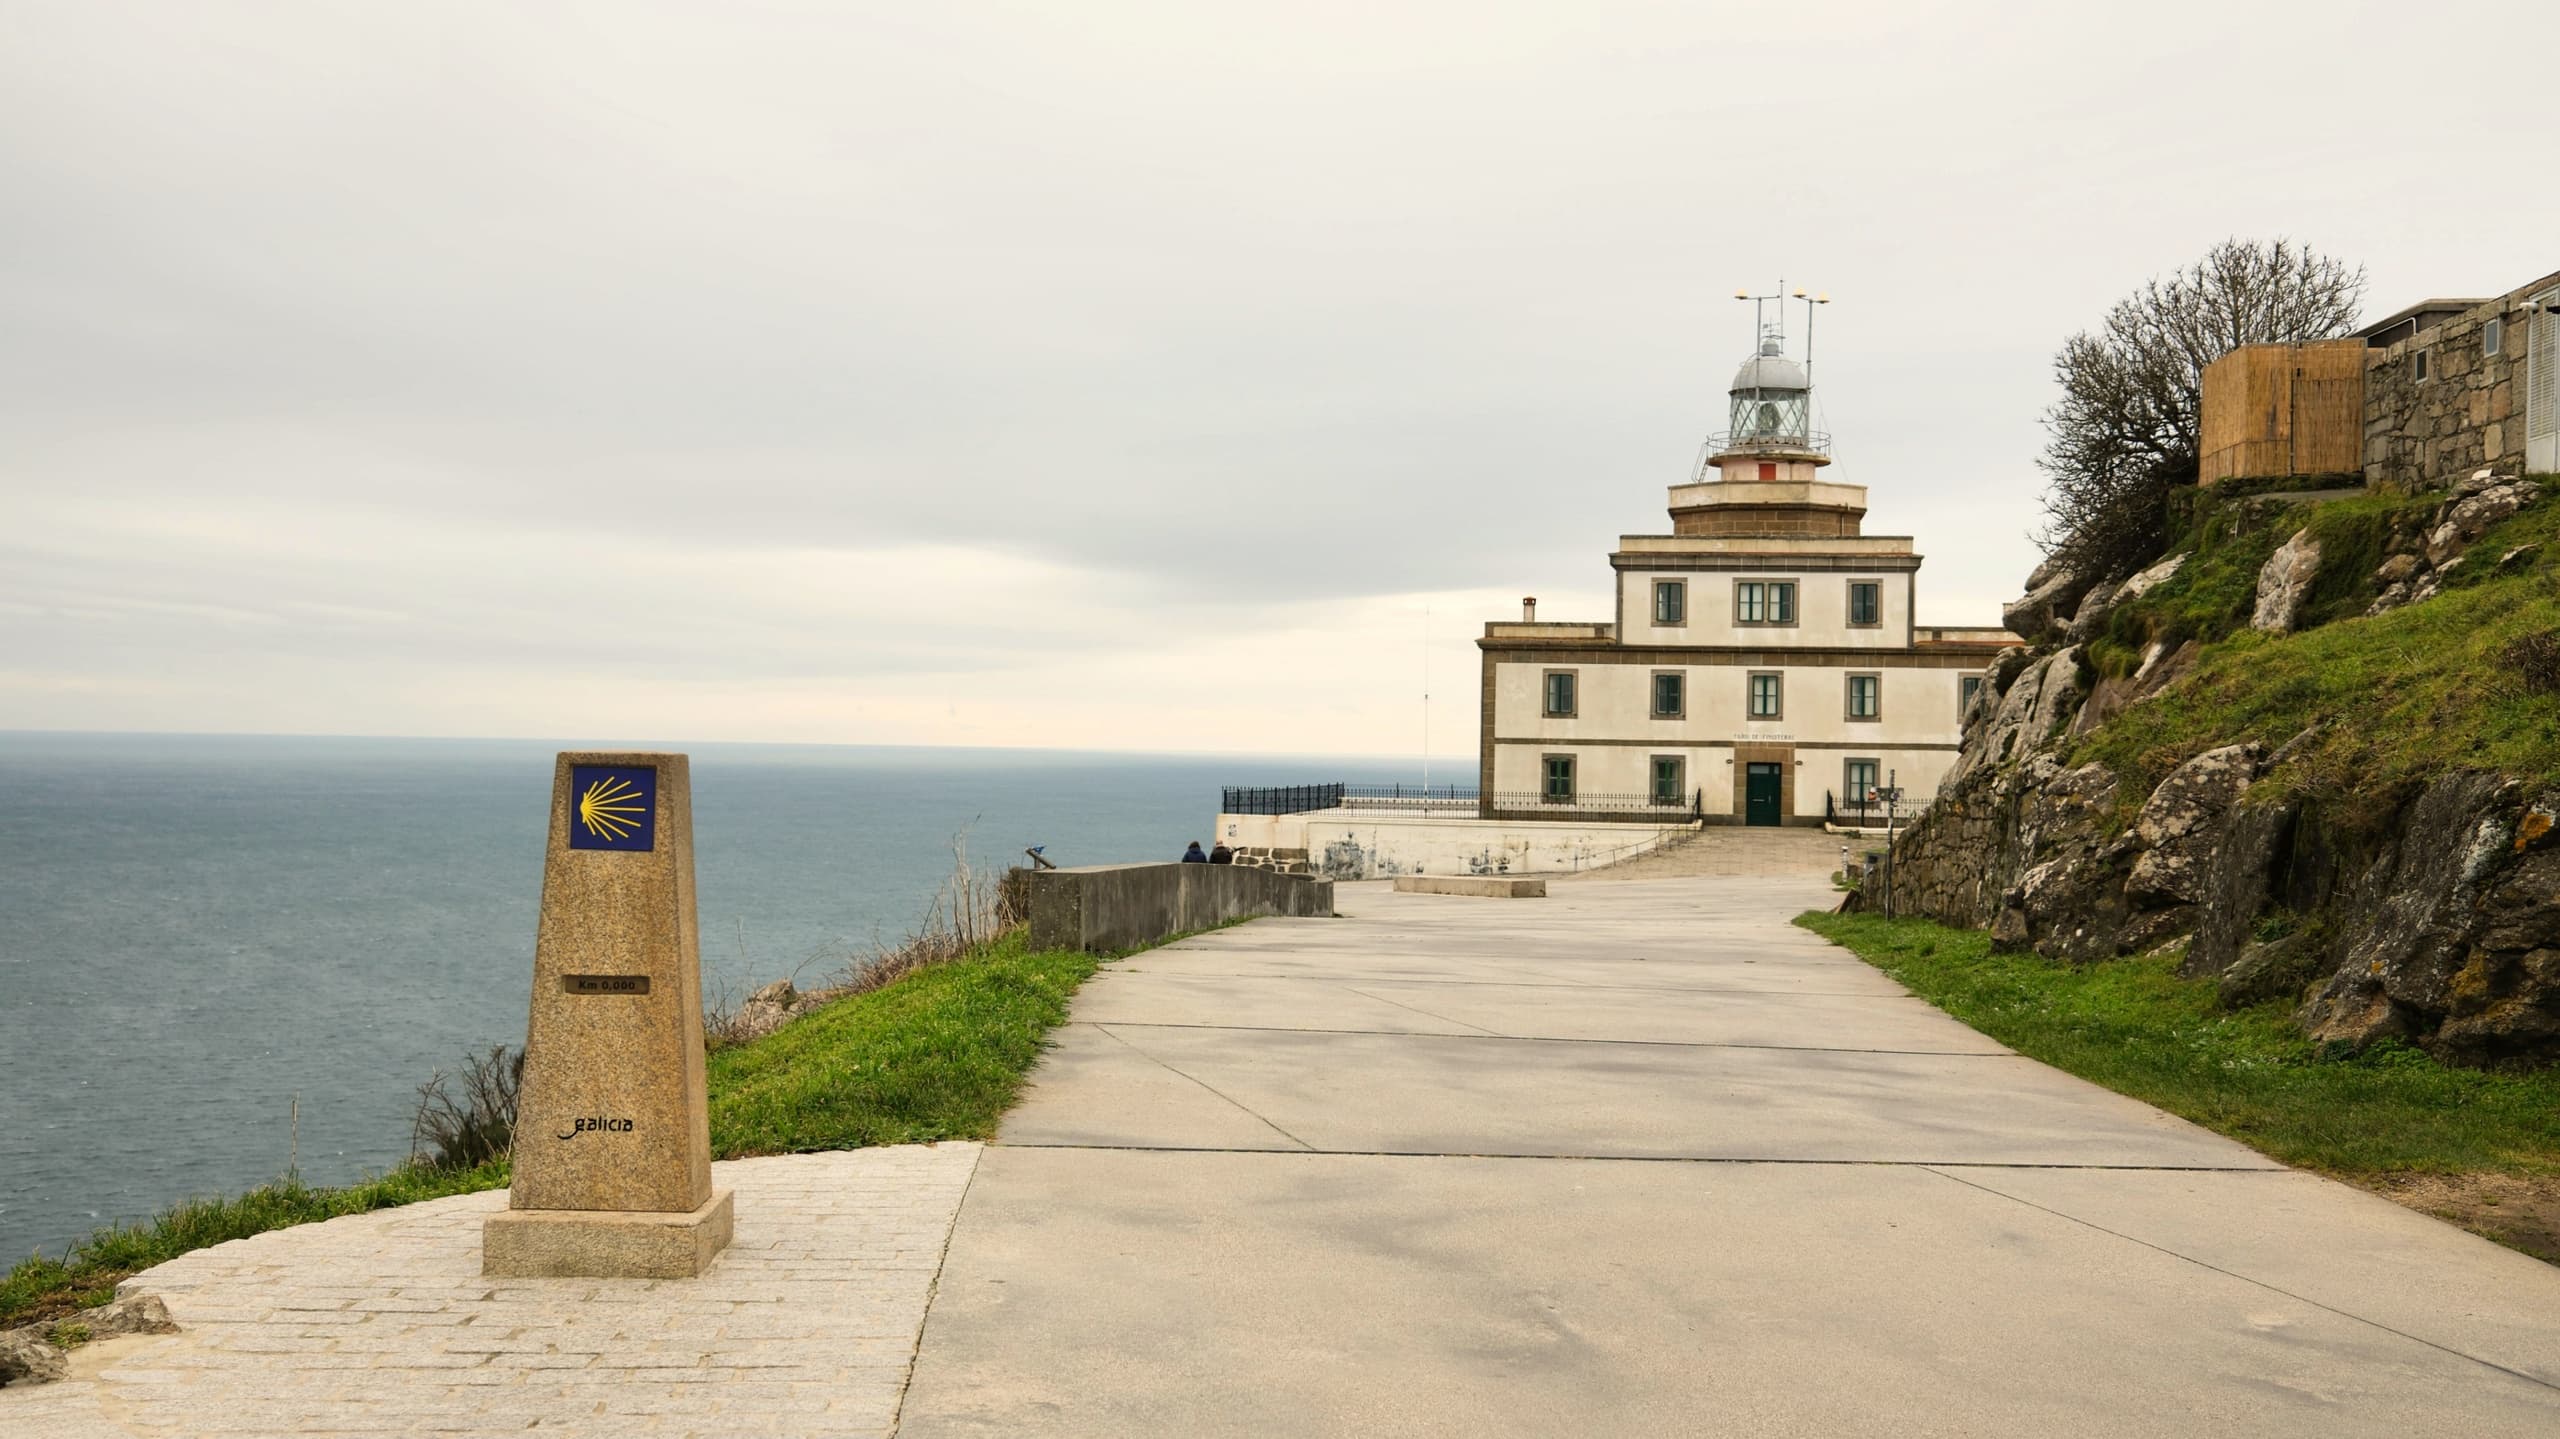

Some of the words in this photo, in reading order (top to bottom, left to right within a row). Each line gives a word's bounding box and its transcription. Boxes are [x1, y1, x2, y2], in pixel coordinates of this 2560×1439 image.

[578, 980, 597, 990] Km
[601, 980, 636, 991] 0,000
[557, 1115, 634, 1140] galicia
